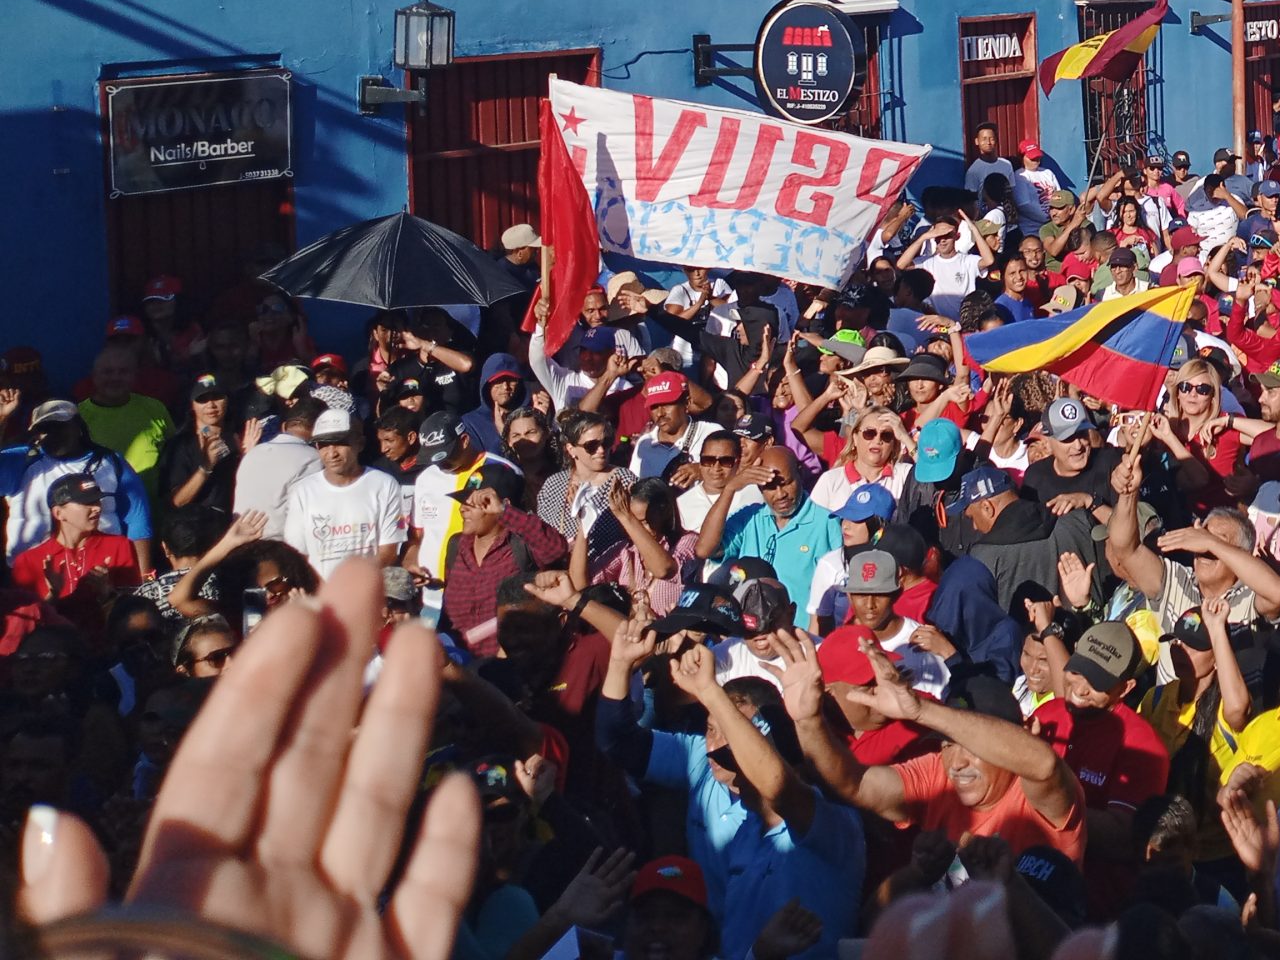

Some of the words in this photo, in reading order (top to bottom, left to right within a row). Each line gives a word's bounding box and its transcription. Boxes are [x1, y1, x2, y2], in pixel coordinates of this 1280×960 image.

[1244, 20, 1278, 42] ESTO
[961, 32, 1022, 61] TIENDA
[777, 88, 788, 99] EL
[789, 86, 839, 102] MESTIZO
[151, 138, 254, 162] Nails/Barber
[1087, 635, 1122, 660] Caterpillar
[1088, 645, 1112, 662] Diesel
